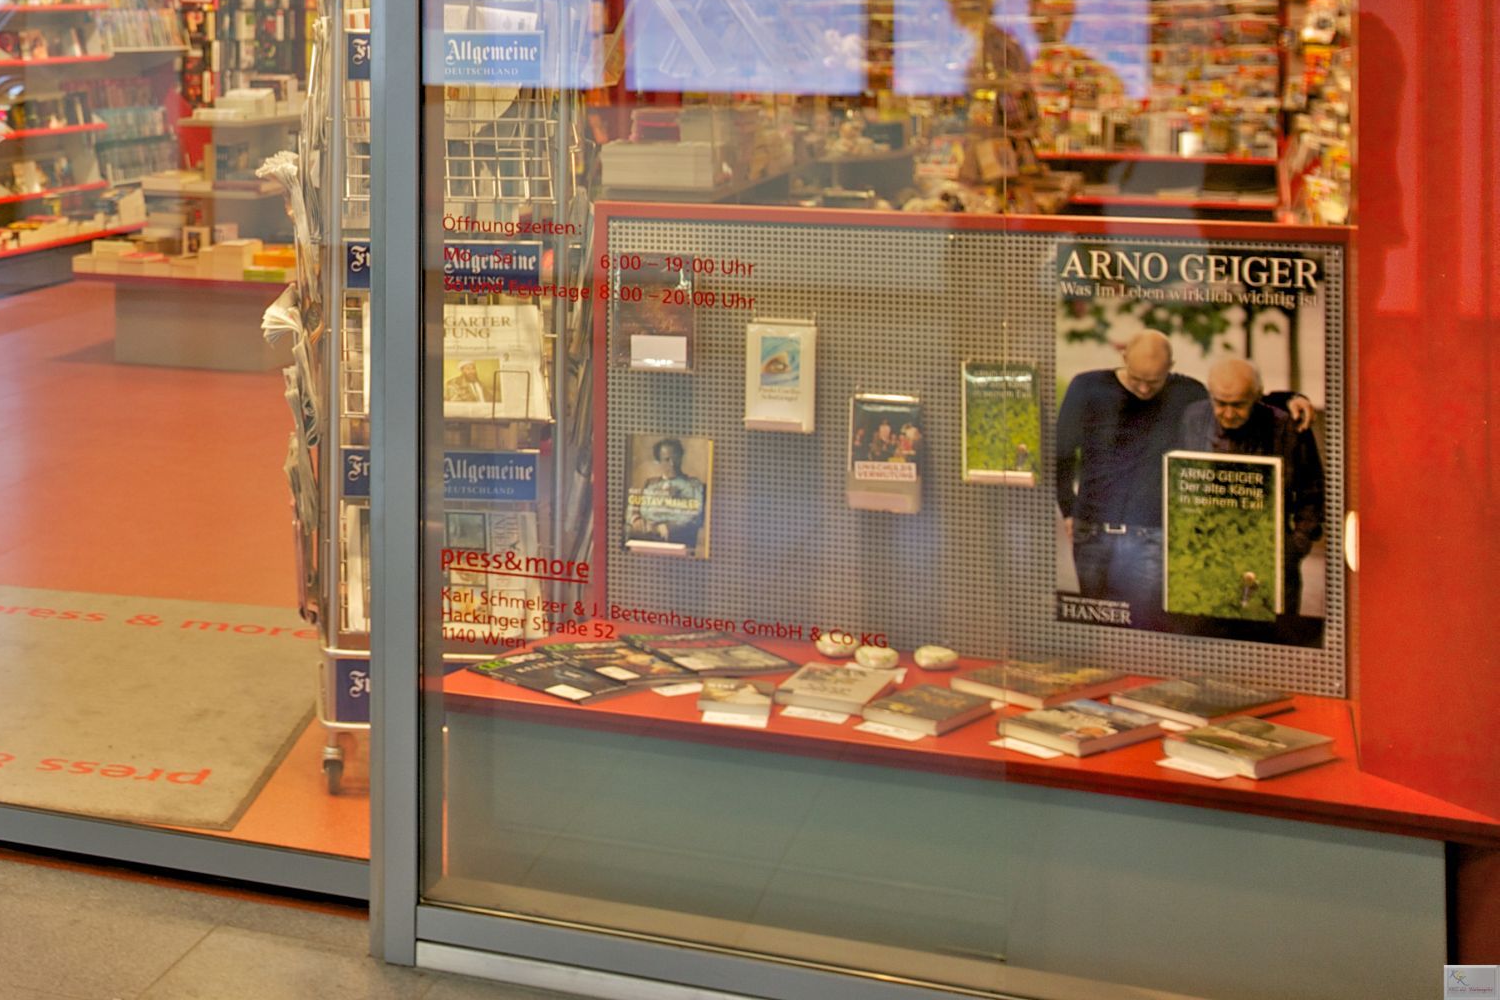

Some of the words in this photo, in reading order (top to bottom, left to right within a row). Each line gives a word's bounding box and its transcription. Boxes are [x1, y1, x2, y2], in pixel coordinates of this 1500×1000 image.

[445, 39, 537, 65] Allgemeine
[445, 67, 518, 75] DEUTSCHLAND
[442, 213, 582, 237] Öffnungszeiten:
[601, 255, 641, 270] 6:00
[665, 257, 715, 273] 19:00
[721, 259, 755, 276] Uhr
[1060, 250, 1169, 282] ARNO
[1179, 253, 1318, 289] GEIGER
[470, 279, 502, 294] und
[509, 280, 590, 302] Feiertage
[600, 284, 642, 301] 8:00
[662, 289, 715, 306] 20:00
[722, 292, 756, 310] Uhr
[1060, 281, 1092, 297] Was
[1095, 282, 1116, 298] im
[1120, 284, 1165, 300] Leben
[1168, 286, 1233, 304] wirklich
[1237, 289, 1295, 309] wichtig
[444, 457, 534, 483] Allgemeine
[1181, 467, 1215, 481] ARNO
[1218, 470, 1263, 485] GEIGER
[441, 548, 590, 578] press&more
[441, 588, 473, 603] Karl
[480, 591, 567, 614] Schmelzer
[573, 601, 585, 616] &
[611, 605, 736, 633] Bettenhausen
[743, 619, 802, 640] GmbH
[810, 627, 821, 642] &
[829, 629, 854, 645] Co
[861, 632, 888, 648] KG
[441, 609, 527, 631] Hackinger
[533, 616, 587, 636] Straße
[594, 623, 615, 640] 52
[1063, 602, 1132, 624] HANSER
[125, 614, 163, 627] &
[180, 618, 319, 640] more
[442, 627, 476, 643] 1140
[482, 631, 526, 649] Wien
[36, 756, 212, 785] press
